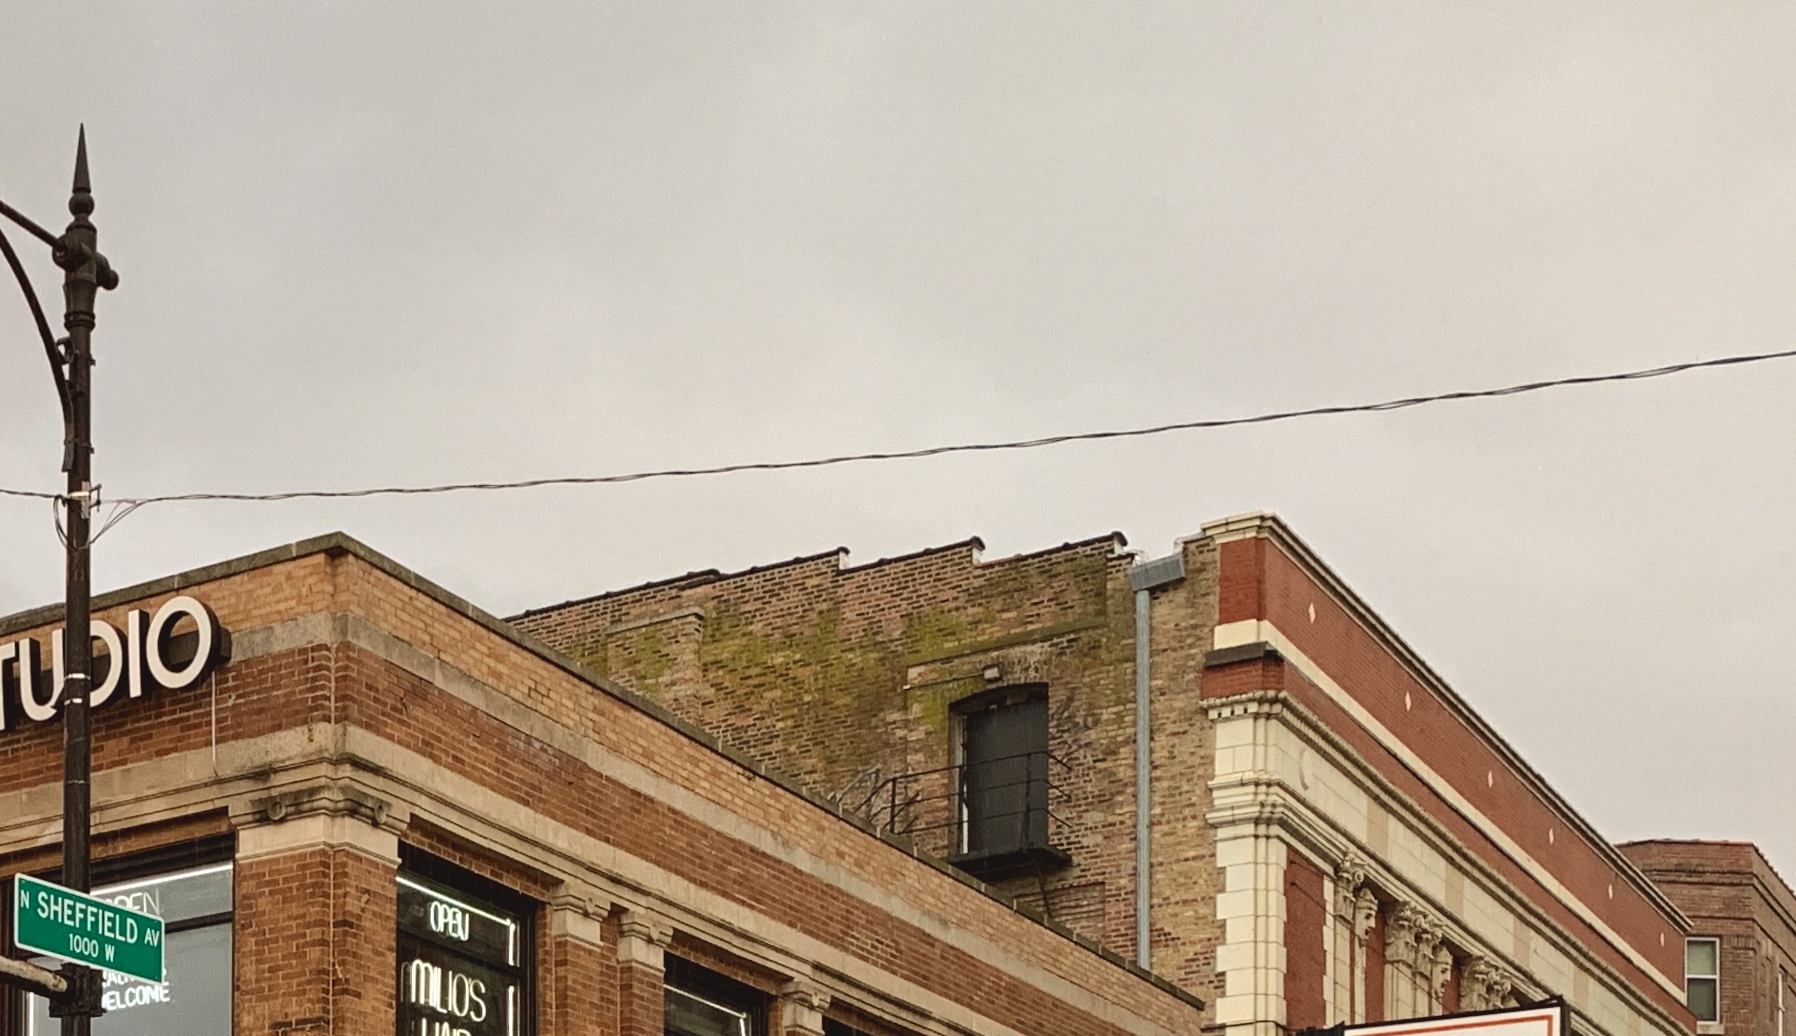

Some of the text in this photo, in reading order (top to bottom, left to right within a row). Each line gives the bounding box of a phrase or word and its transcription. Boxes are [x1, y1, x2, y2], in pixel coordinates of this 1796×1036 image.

[20, 889, 160, 947] N SHEFFIELD AV
[429, 900, 470, 941] OPEN
[69, 933, 115, 962] 1000 W
